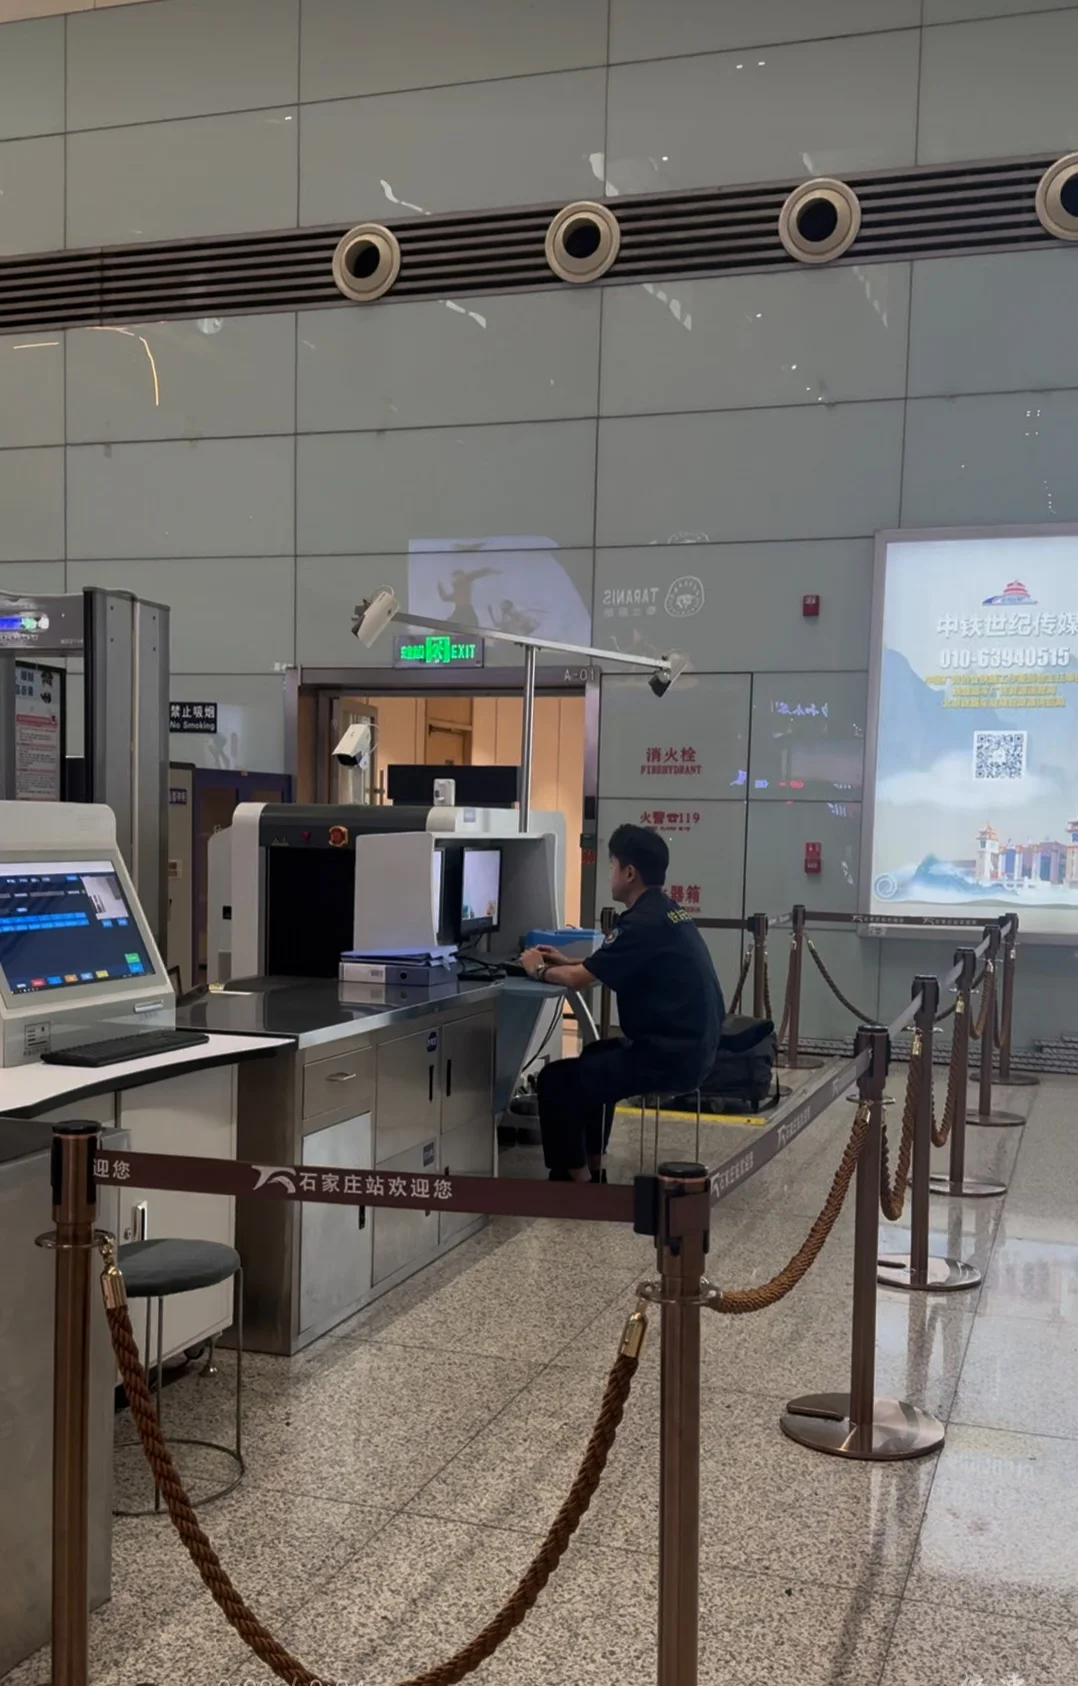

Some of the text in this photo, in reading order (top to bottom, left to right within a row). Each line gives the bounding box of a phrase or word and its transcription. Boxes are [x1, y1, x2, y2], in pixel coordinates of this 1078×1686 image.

[936, 612, 1078, 638] 中铁世纪传媒
[451, 643, 476, 660] EXIT
[939, 647, 1071, 668] 010-63940515
[564, 667, 594, 682] A-01
[170, 704, 215, 719] 禁止吸烟
[170, 720, 215, 732] No Smoking
[646, 746, 697, 763] 消火栓
[299, 1171, 453, 1200] 石家庄站欢迎您
